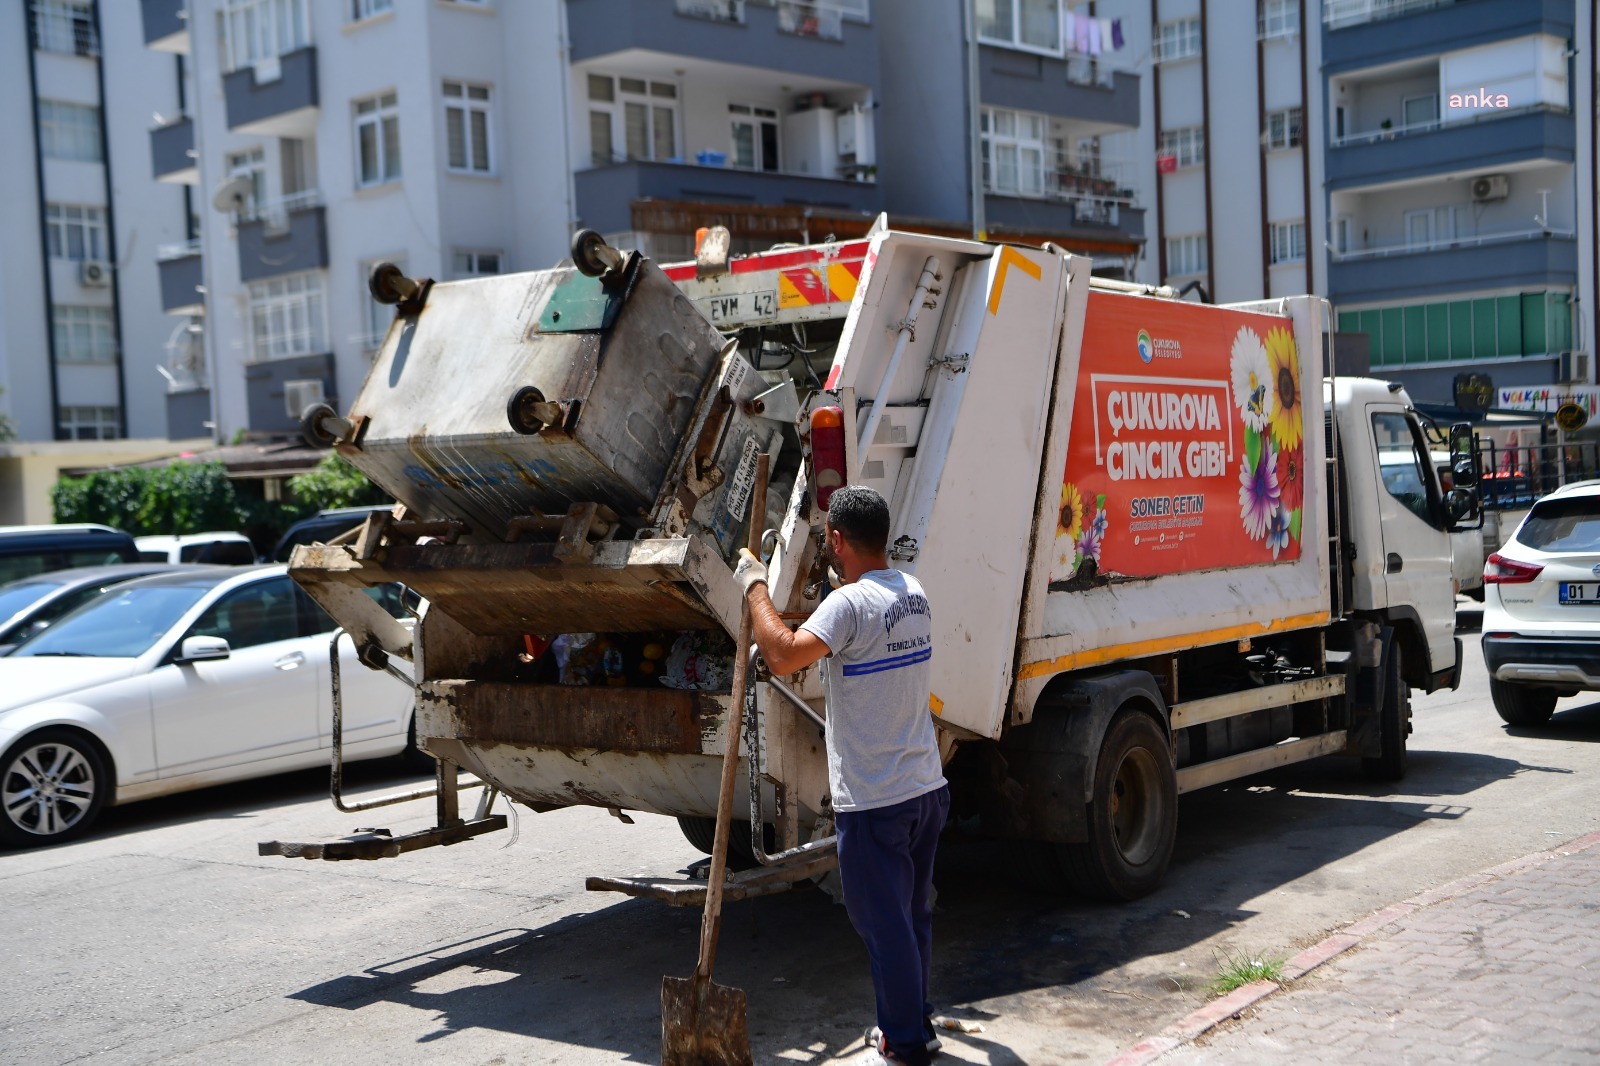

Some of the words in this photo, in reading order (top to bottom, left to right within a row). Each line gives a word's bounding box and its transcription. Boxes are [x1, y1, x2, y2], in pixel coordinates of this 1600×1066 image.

[711, 298, 739, 320] EVM
[754, 295, 772, 316] 42
[1502, 389, 1549, 403] VOLKAN
[1107, 390, 1221, 437] ÇUKUROVA
[1106, 441, 1183, 481] CINCIK
[1130, 495, 1170, 518] SONER
[1172, 493, 1204, 518] ÇETİN
[1568, 585, 1583, 599] 01
